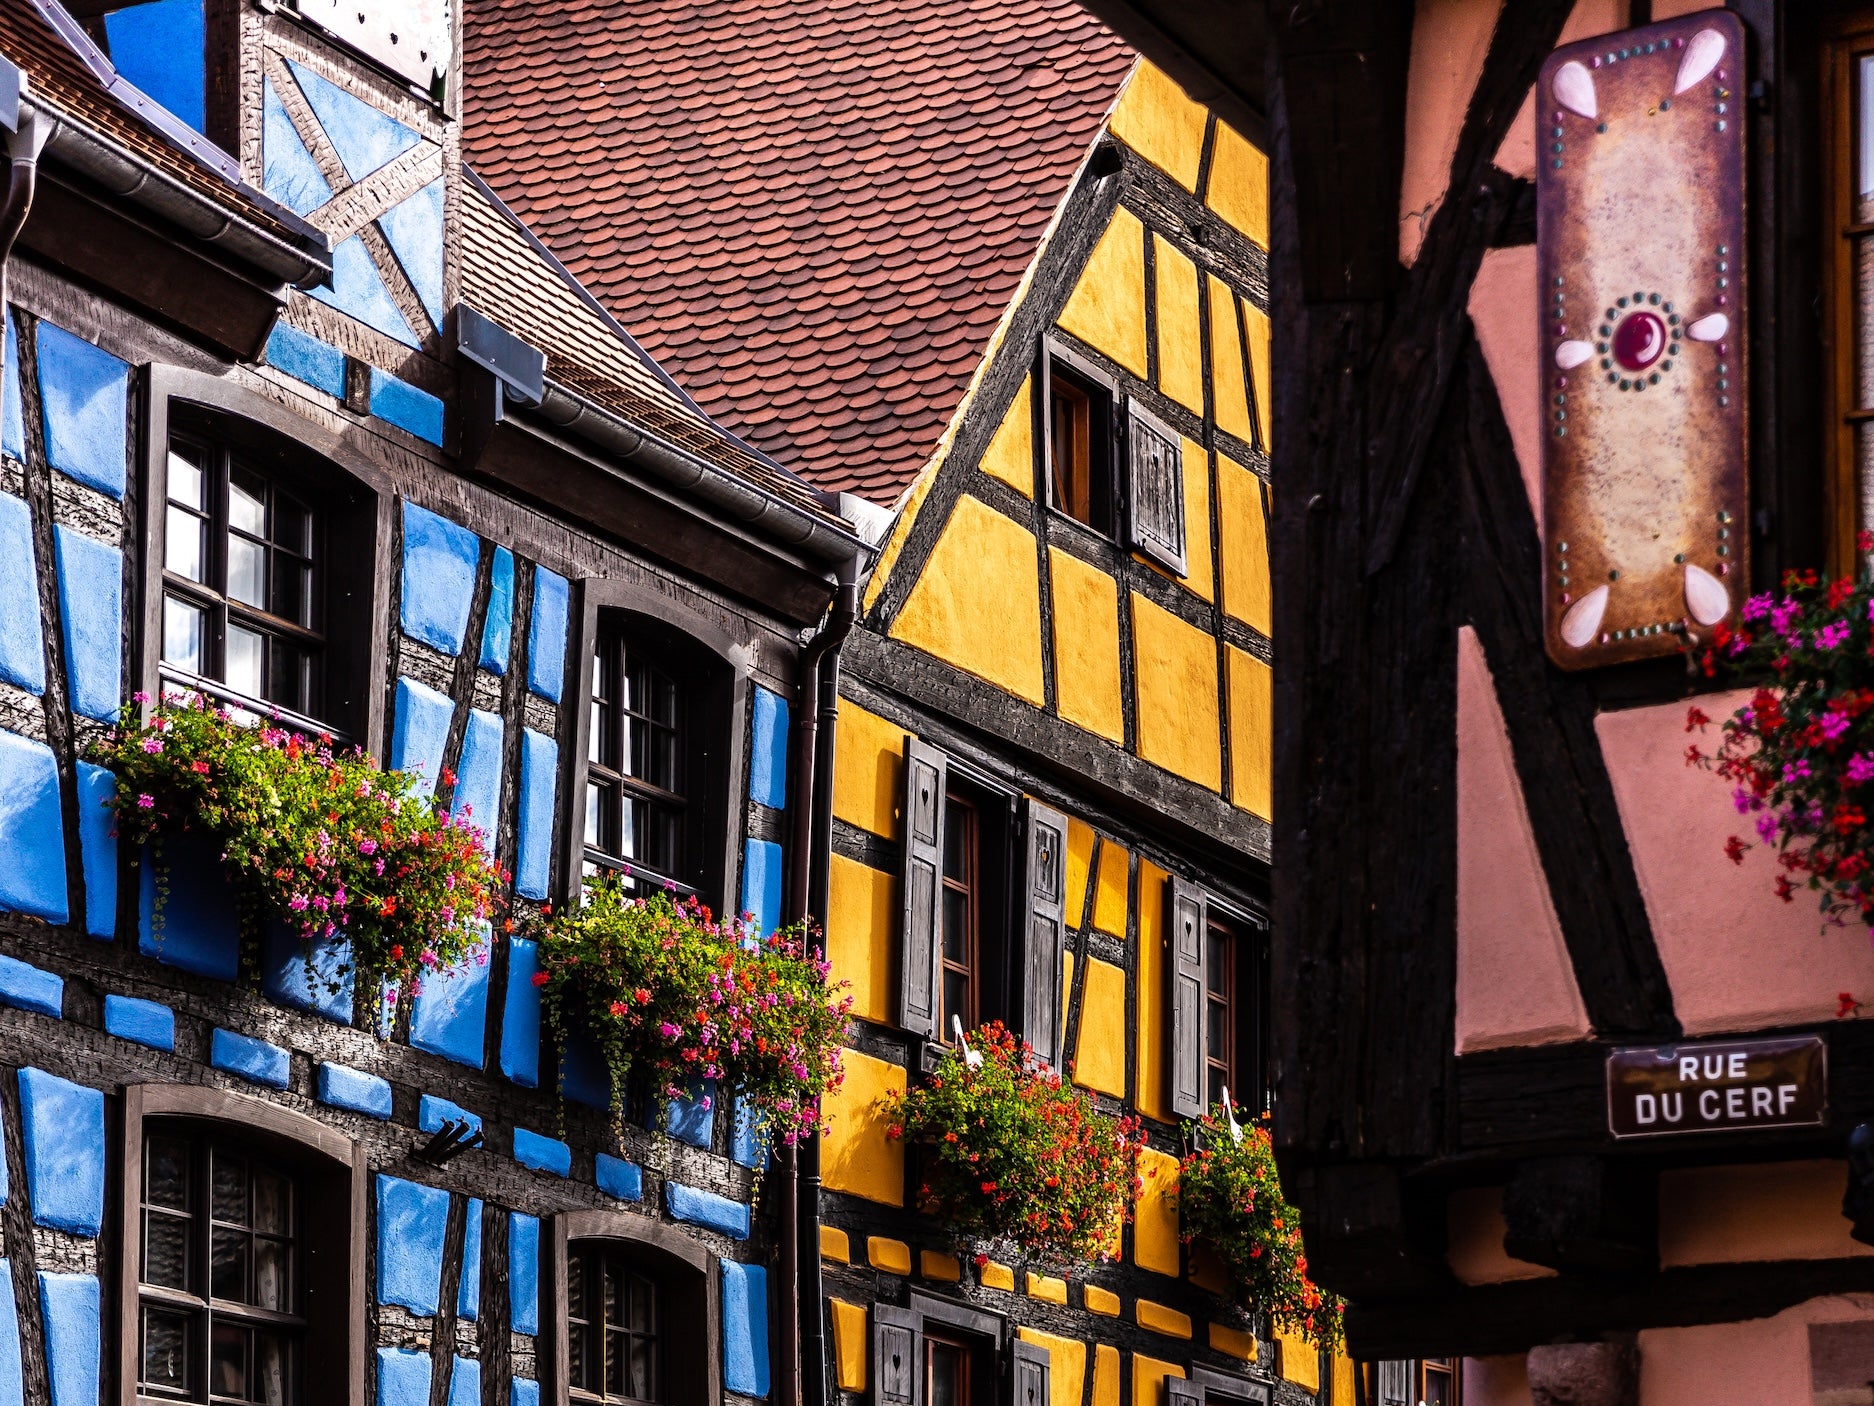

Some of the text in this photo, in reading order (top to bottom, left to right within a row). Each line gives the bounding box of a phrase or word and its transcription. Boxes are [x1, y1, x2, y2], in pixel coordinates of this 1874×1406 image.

[1679, 1053, 1748, 1081] RUE
[1635, 1084, 1798, 1124] DU CERF
